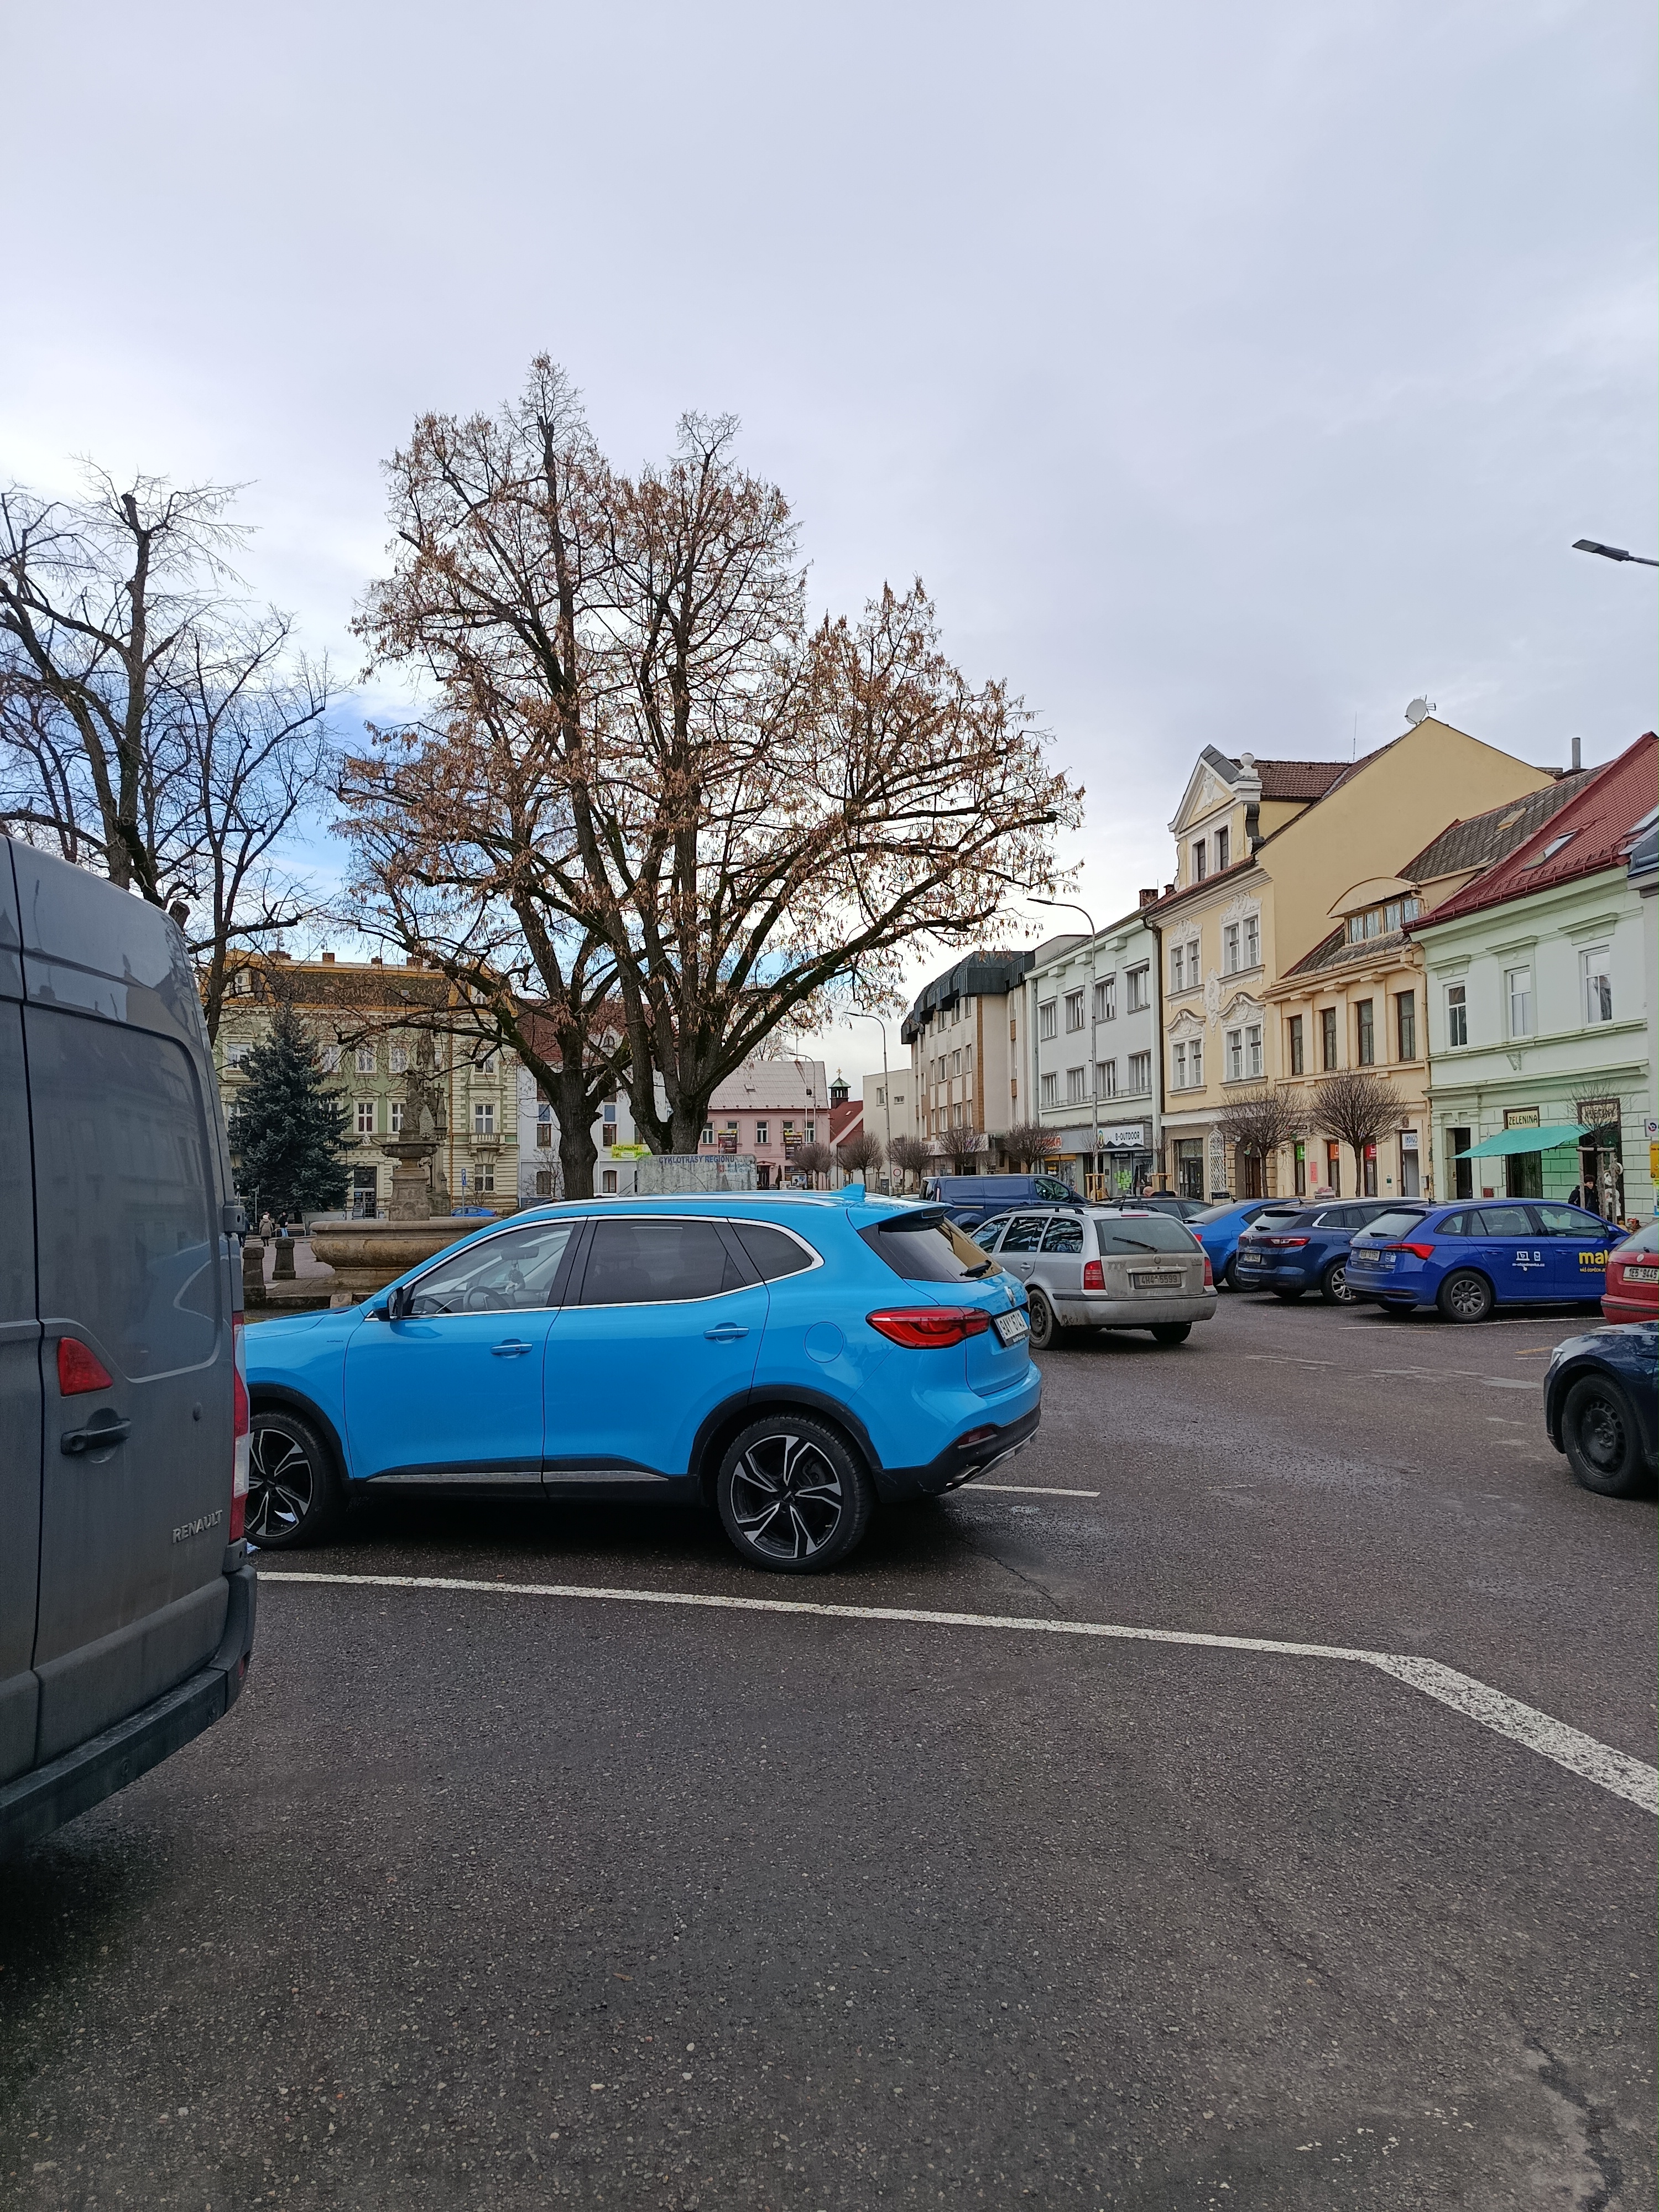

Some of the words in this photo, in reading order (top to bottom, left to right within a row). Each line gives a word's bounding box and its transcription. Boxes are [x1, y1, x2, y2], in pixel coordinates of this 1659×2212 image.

[1509, 1114, 1537, 1125] ZELENINA
[1629, 1268, 1639, 1277] 1E5
[1642, 1269, 1658, 1279] 9445
[1141, 1276, 1154, 1284] 4H4
[1160, 1275, 1177, 1284] 5599
[172, 1509, 223, 1543] RENAULT
